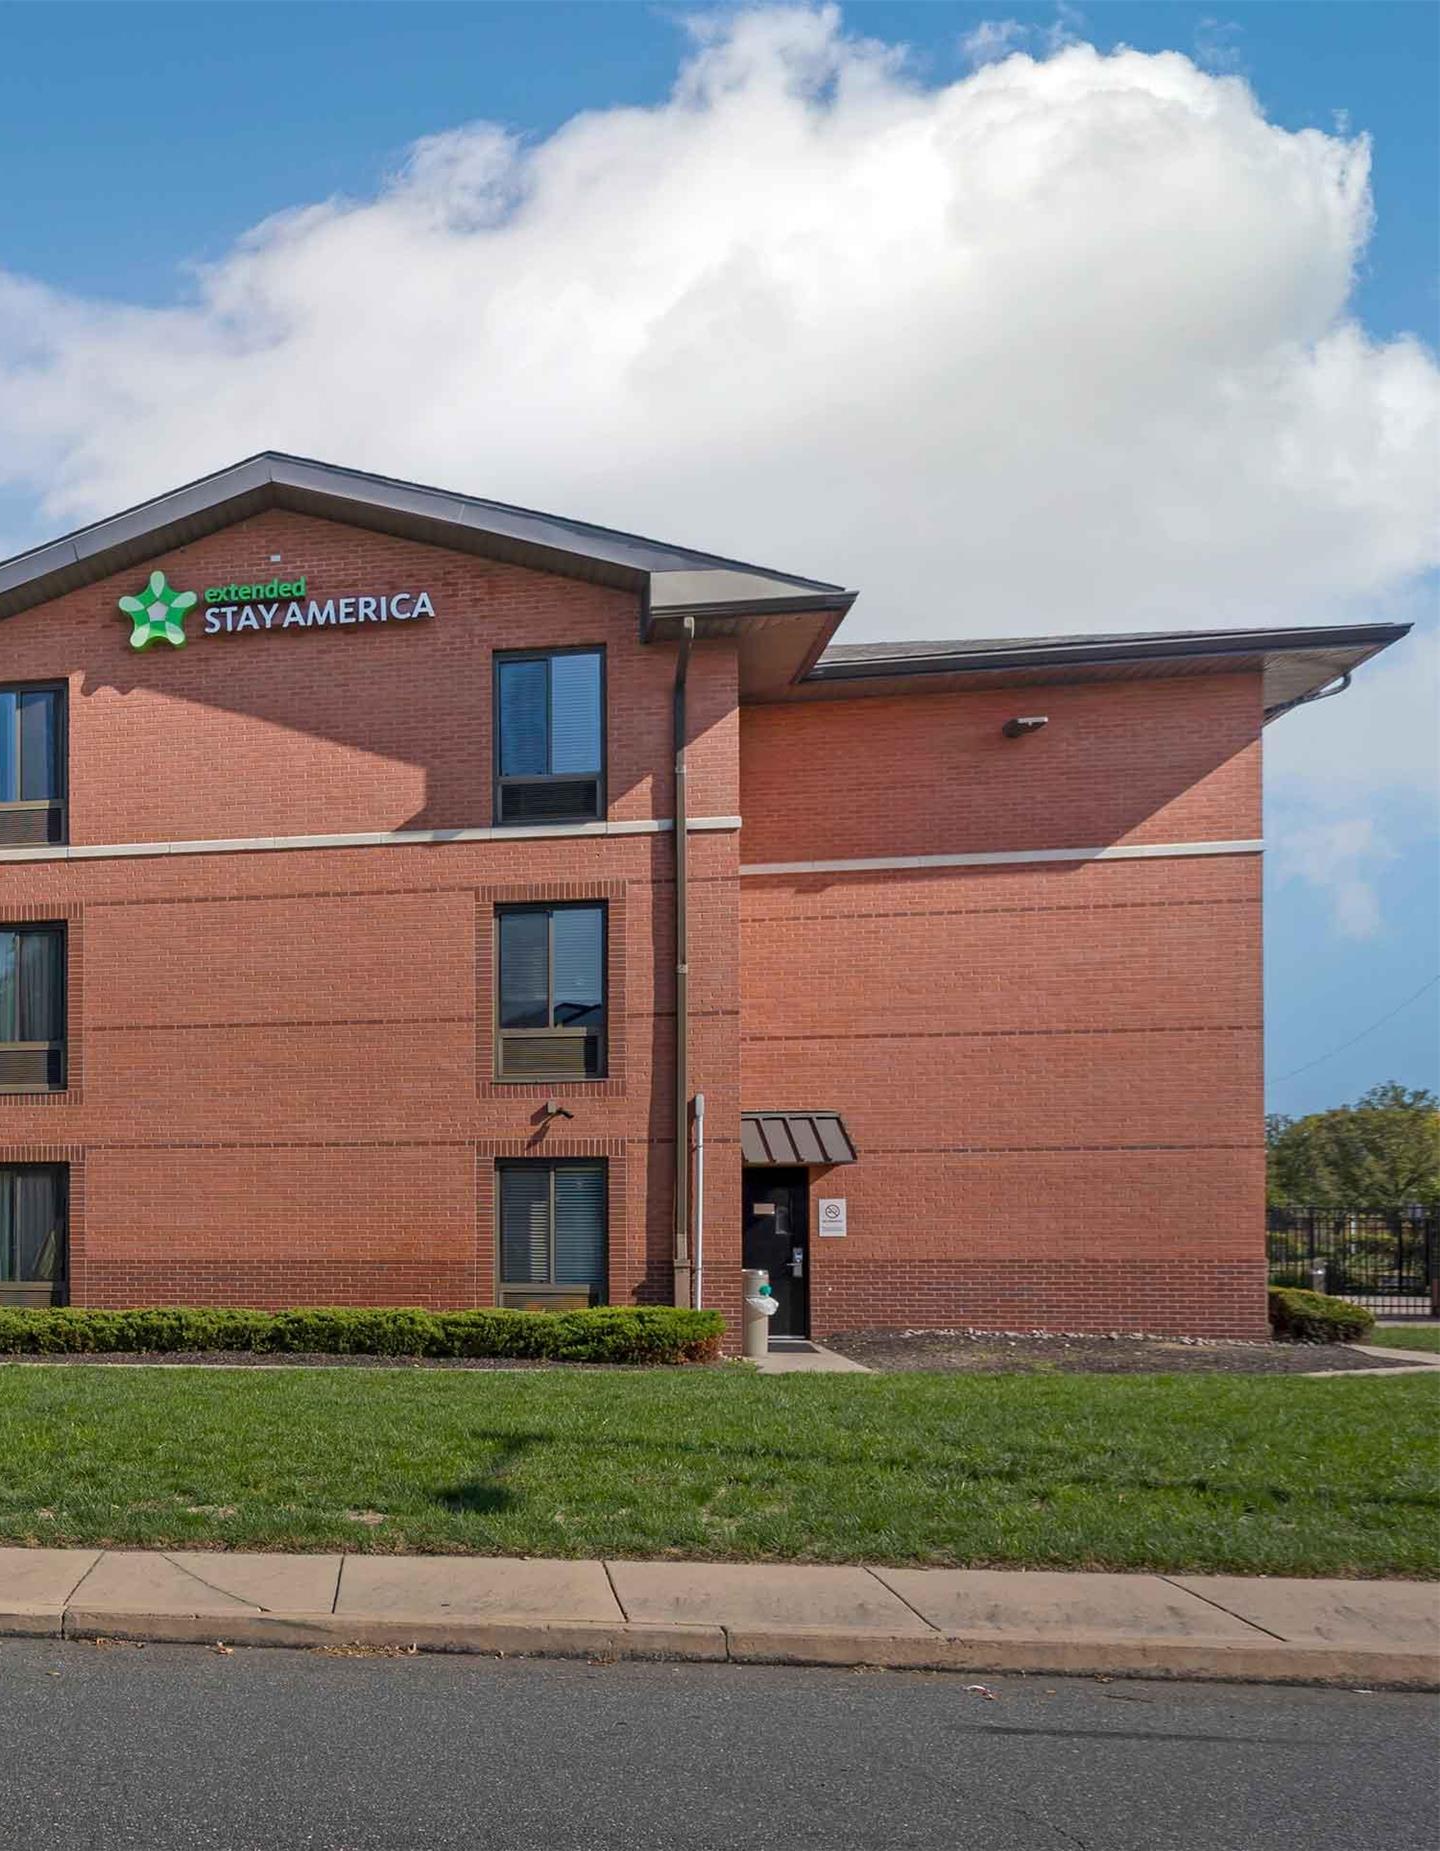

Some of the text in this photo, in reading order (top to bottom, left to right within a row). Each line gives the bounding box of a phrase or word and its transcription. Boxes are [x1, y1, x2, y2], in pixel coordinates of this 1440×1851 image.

[204, 576, 306, 602] extended
[204, 592, 436, 633] STAY AMERICA
